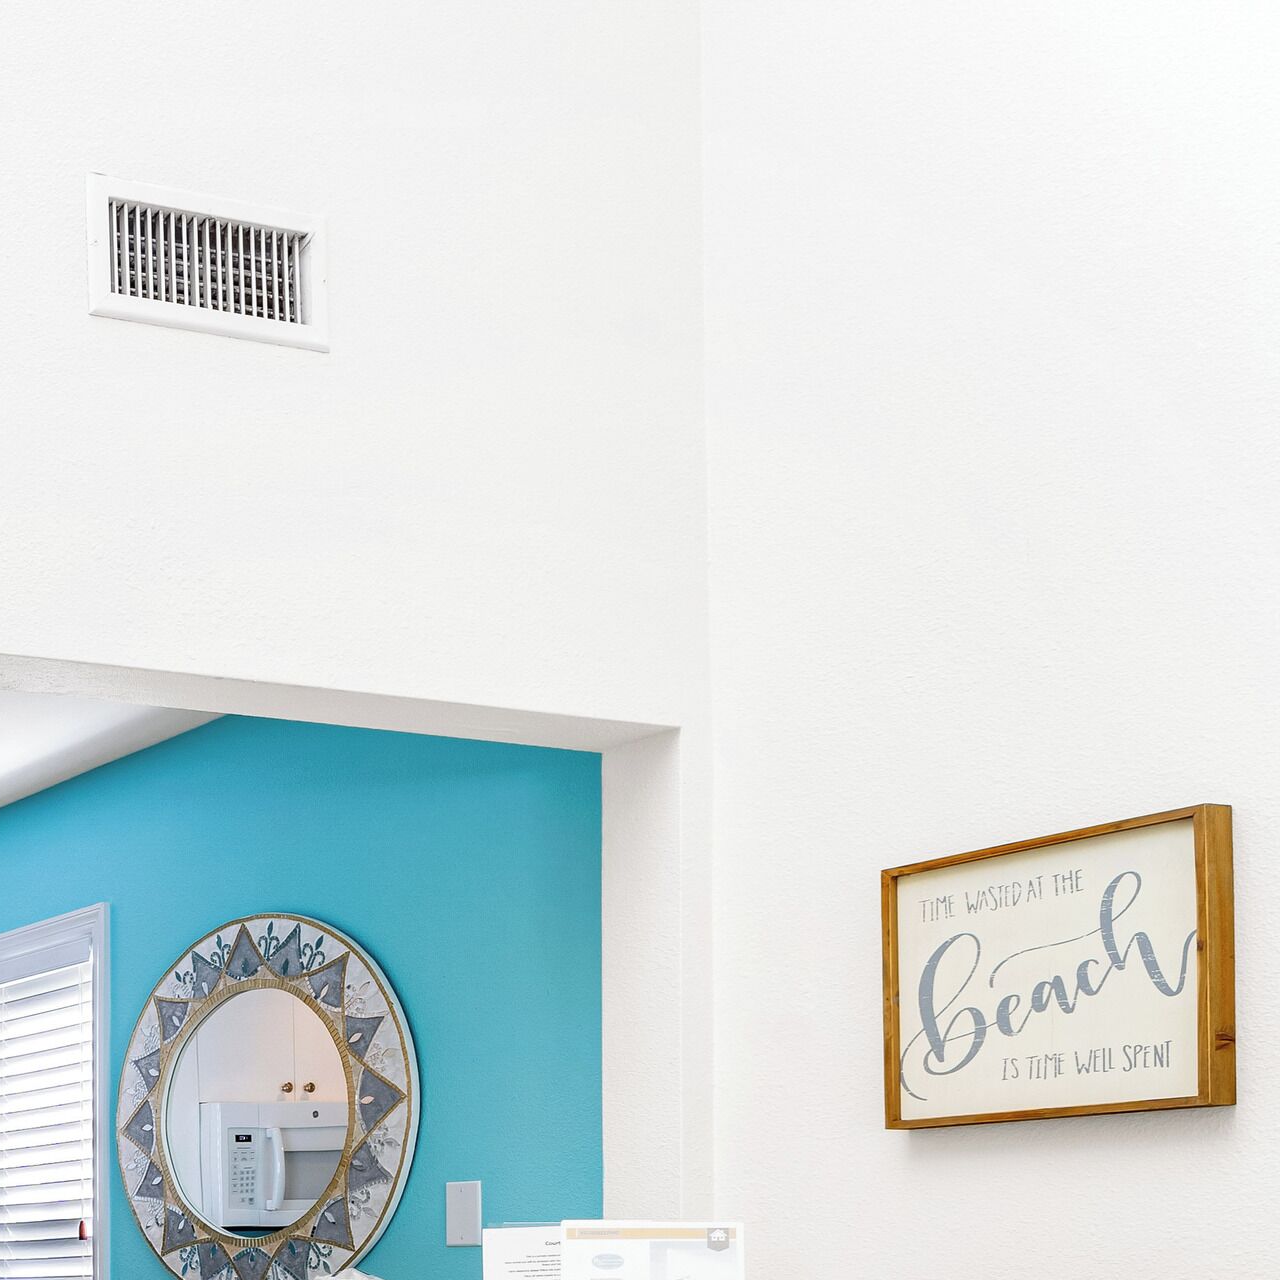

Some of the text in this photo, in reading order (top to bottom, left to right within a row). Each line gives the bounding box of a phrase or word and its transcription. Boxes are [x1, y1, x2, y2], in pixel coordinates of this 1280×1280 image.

[918, 869, 1085, 923] TIME WASTED AT THE
[900, 870, 1197, 1101] beach
[1001, 1040, 1173, 1081] IS TIME WELL SPENT
